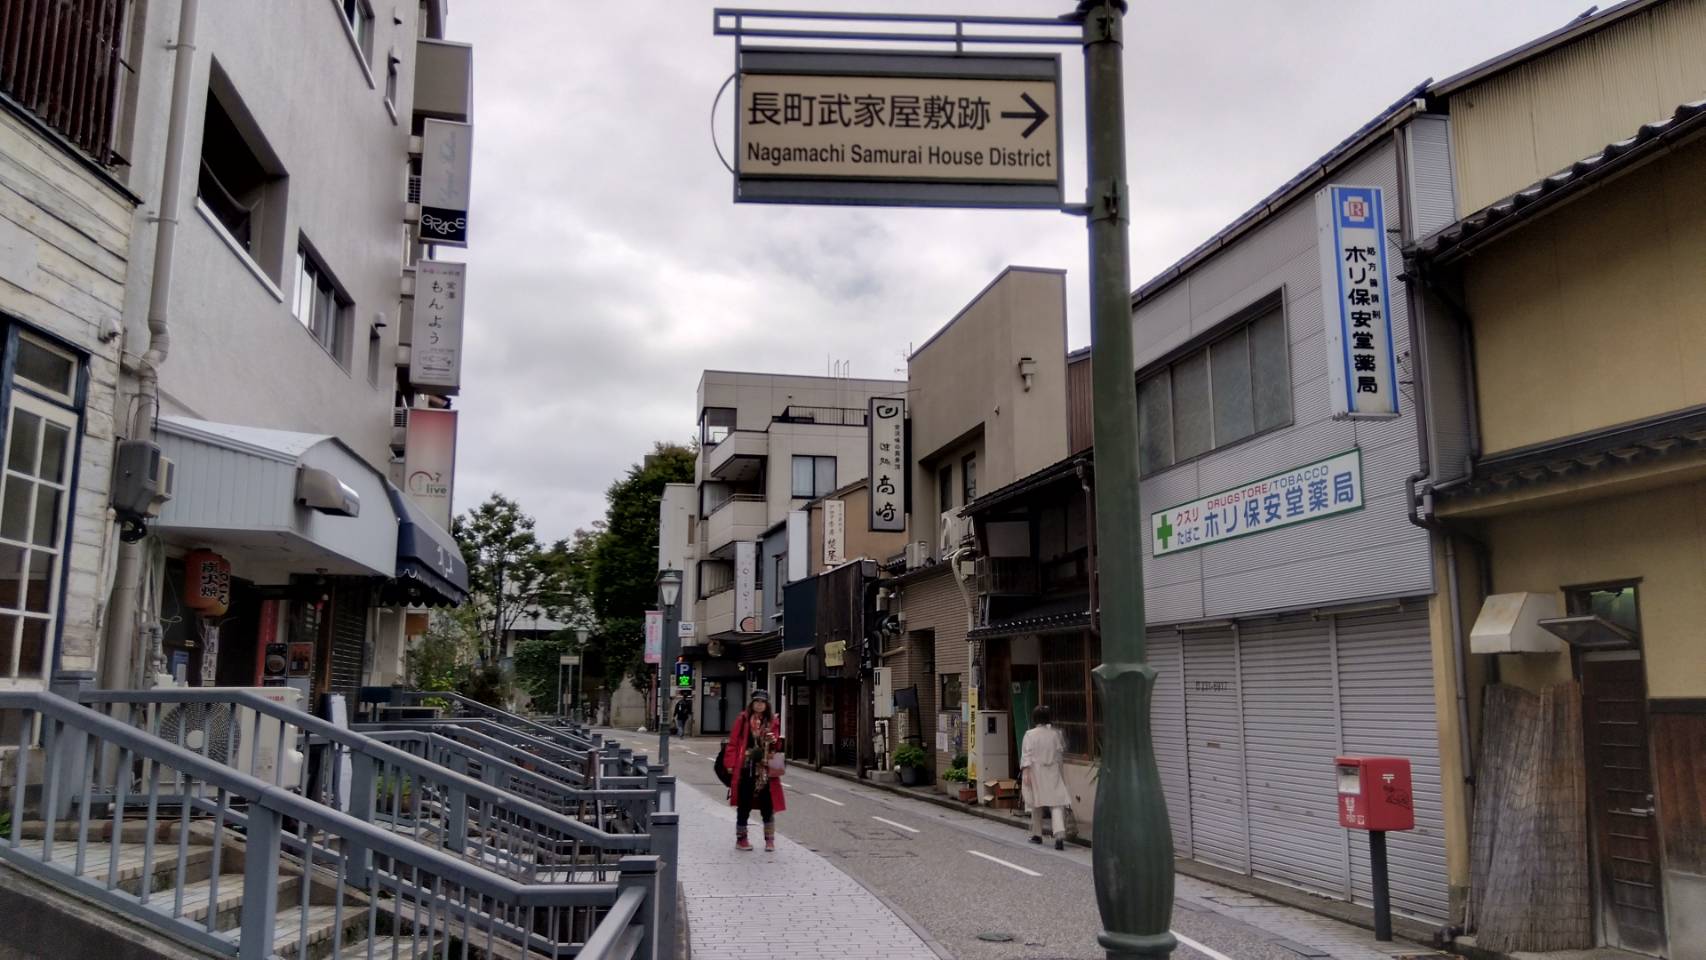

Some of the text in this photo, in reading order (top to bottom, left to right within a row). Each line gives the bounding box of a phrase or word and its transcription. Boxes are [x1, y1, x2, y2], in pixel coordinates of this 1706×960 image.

[747, 92, 991, 131] 長町武家屋敷跡
[747, 142, 1052, 168] Nagamachi Samurai House District
[421, 214, 465, 235] GRACE
[428, 280, 444, 344] もんよう
[1345, 245, 1378, 394] ホリ保安堂薬局
[1176, 507, 1199, 527] クスリ
[1204, 471, 1354, 538] ホリ保安堂薬局
[1177, 526, 1200, 546] たばこ
[680, 664, 690, 675] P
